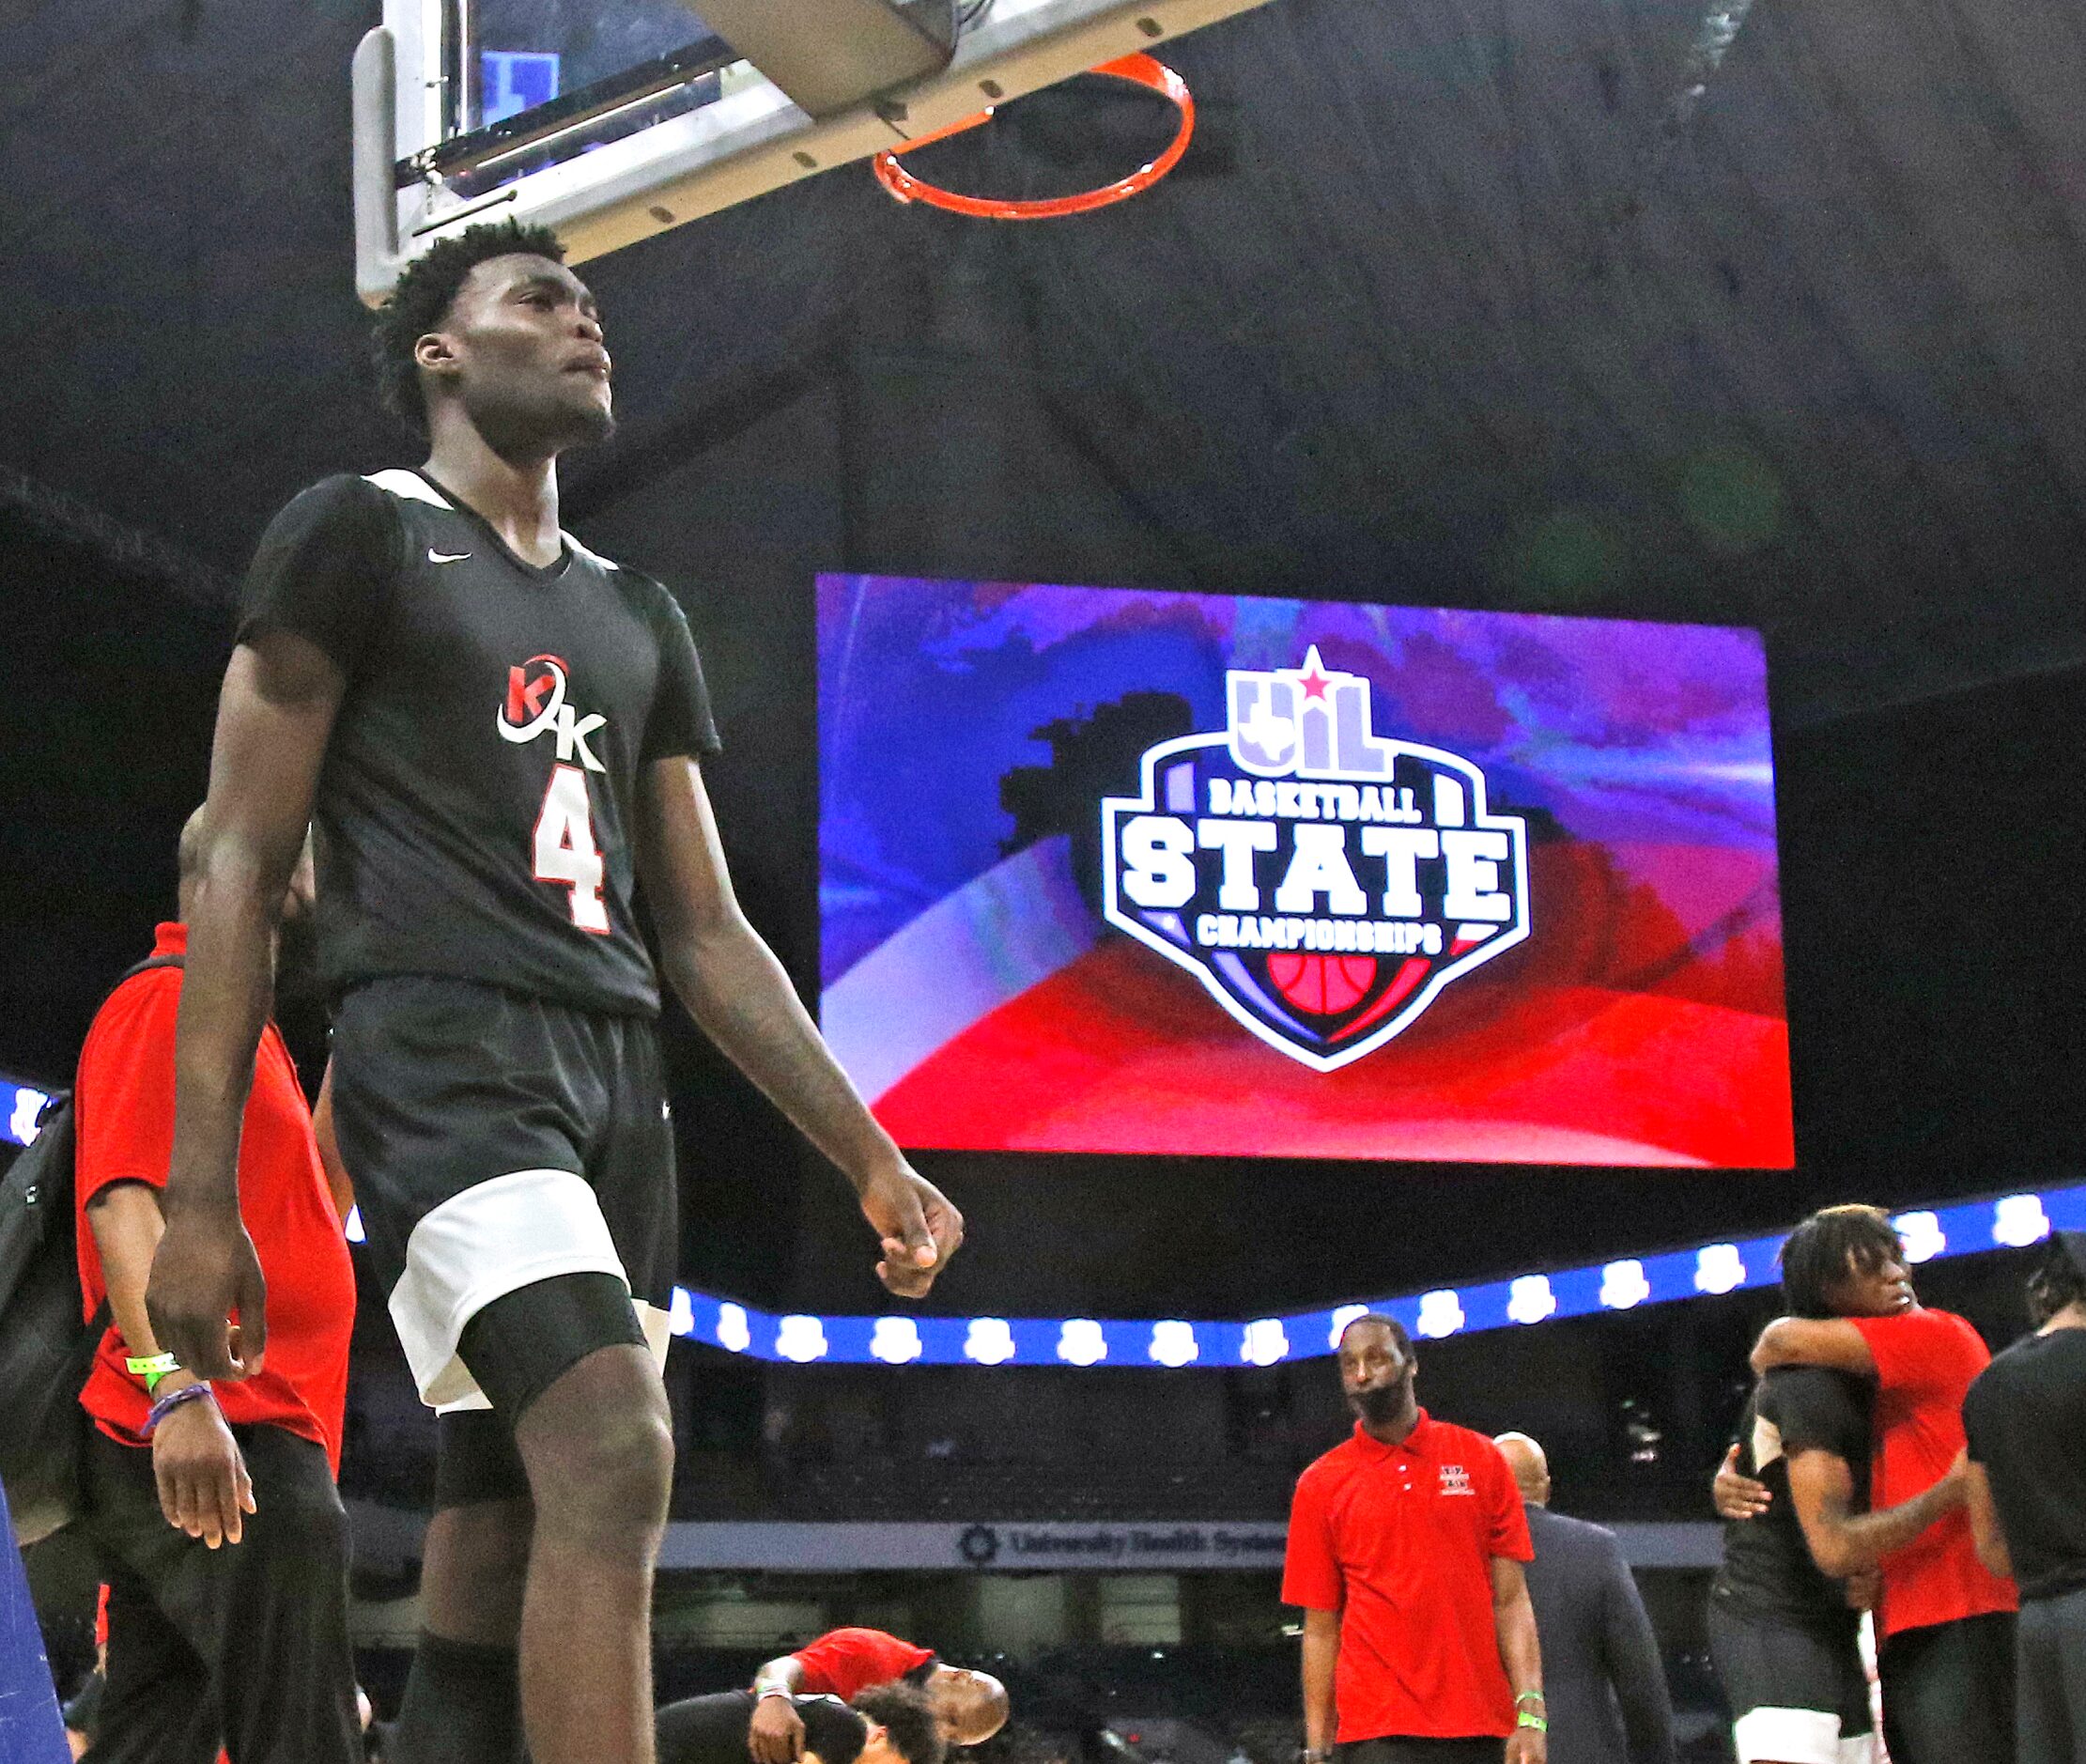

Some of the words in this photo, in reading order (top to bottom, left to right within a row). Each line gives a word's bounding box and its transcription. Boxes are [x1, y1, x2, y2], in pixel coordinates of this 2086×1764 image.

[1209, 778, 1422, 824] BASKETBALL
[532, 763, 610, 935] 4
[1121, 815, 1511, 921] STATE
[1196, 915, 1444, 956] CHAMPIONSHIPS
[1011, 1530, 1125, 1558] University
[1129, 1530, 1206, 1554] Health
